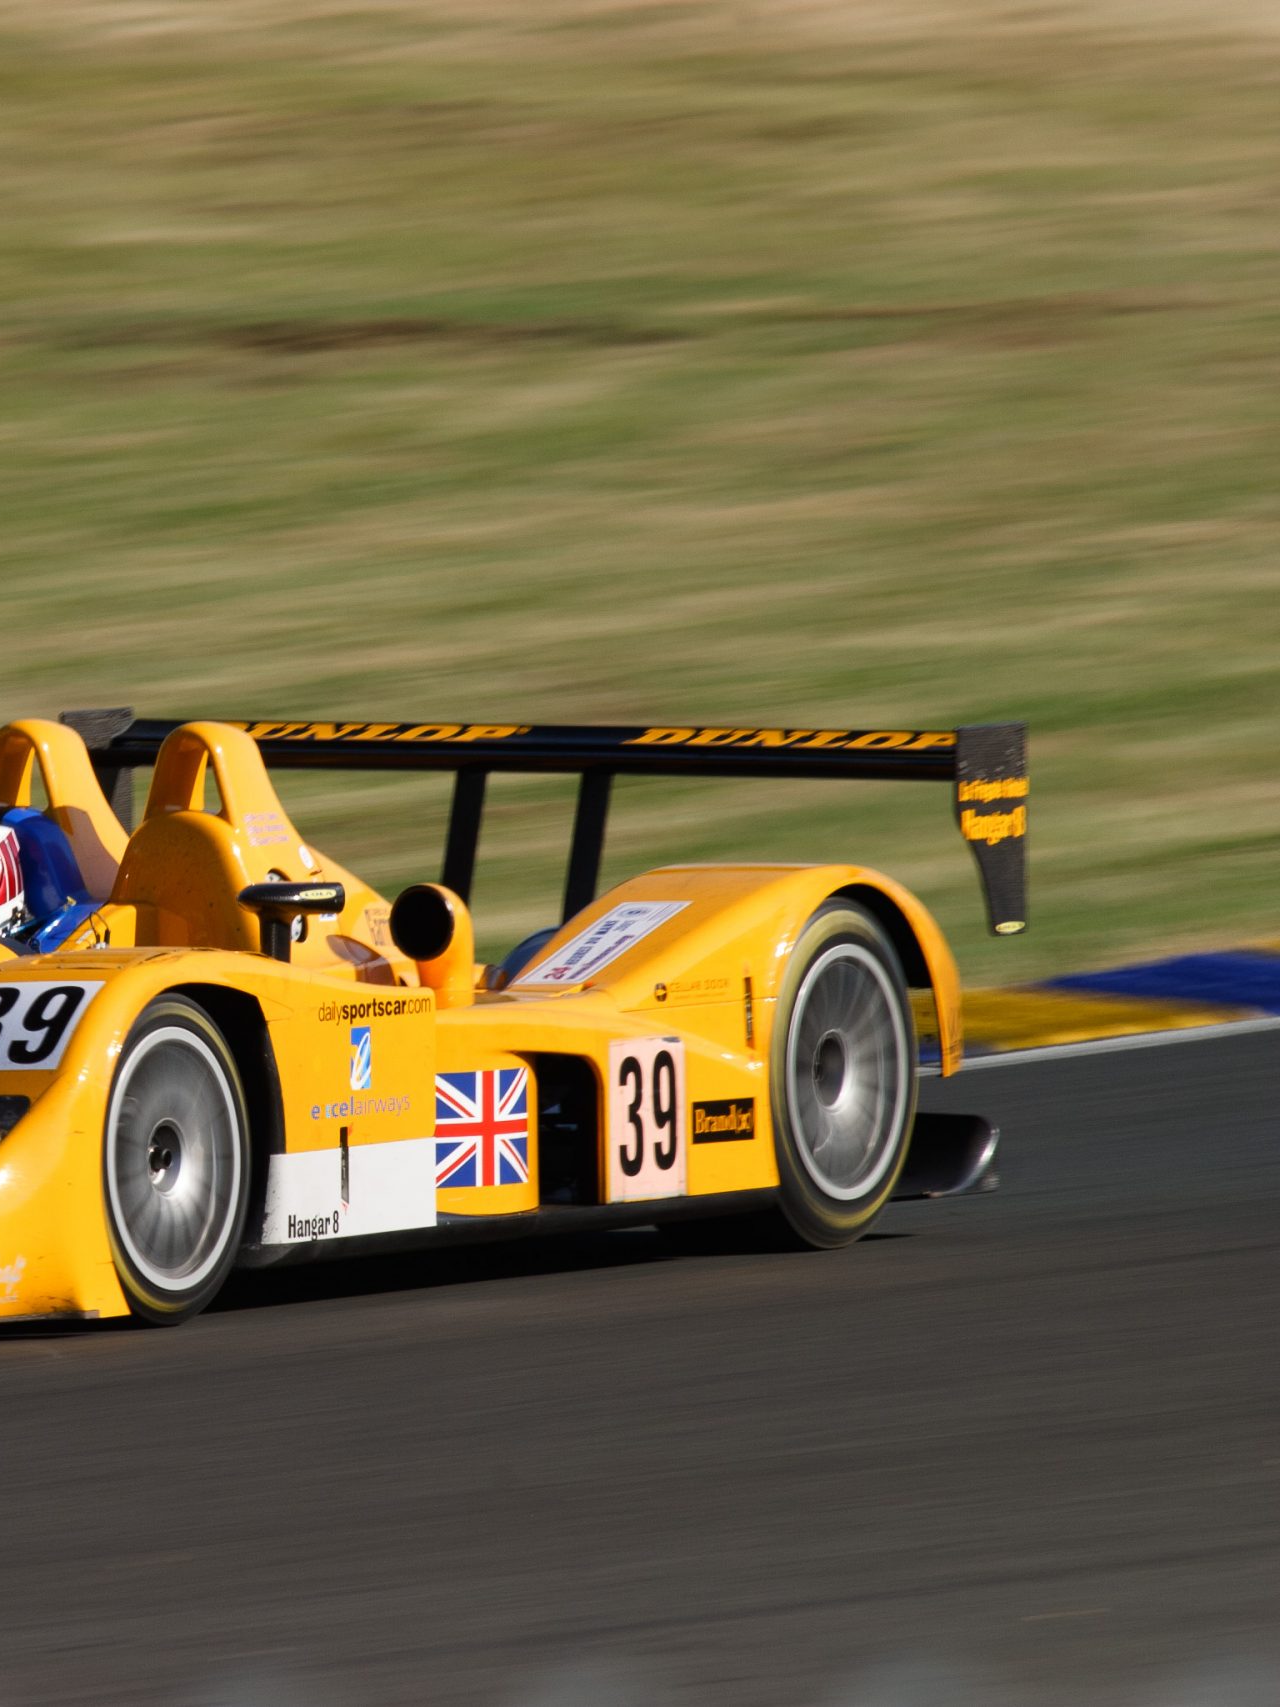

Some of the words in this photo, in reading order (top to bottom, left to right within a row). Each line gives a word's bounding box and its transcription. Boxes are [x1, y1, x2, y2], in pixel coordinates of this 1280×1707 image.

[622, 727, 957, 749] DUNLOP
[318, 998, 431, 1026] dailysportscar.com
[619, 1050, 677, 1177] 39
[288, 1214, 331, 1241] Hangar
[332, 1210, 340, 1235] 8
